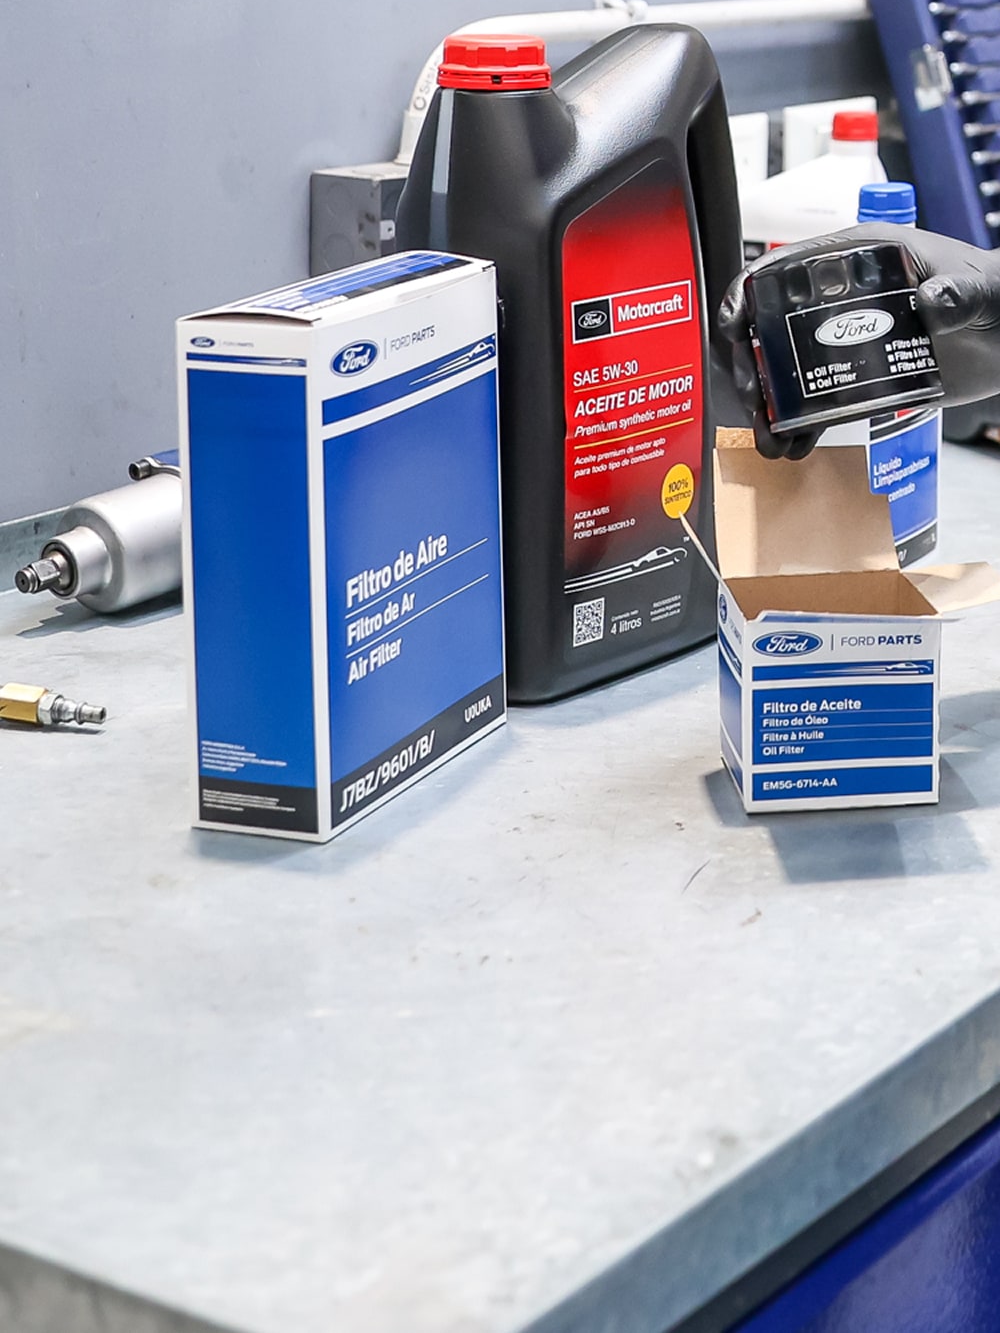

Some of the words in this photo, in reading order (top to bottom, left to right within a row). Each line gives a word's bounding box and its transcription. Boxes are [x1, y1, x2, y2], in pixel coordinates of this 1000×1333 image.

[617, 294, 684, 322] Motorcraft
[583, 312, 602, 327] Ford
[833, 315, 878, 340] Ford
[339, 346, 373, 372] Ford
[390, 335, 410, 351] FORD
[410, 325, 436, 344] PARTS
[573, 368, 600, 387] SAE
[602, 359, 638, 381] 5W-30
[814, 366, 828, 377] Oil
[828, 361, 852, 374] Filter
[833, 371, 857, 386] Filter
[574, 391, 626, 418] ACEITE
[628, 387, 646, 409] DE
[648, 375, 693, 401] MOTOR
[574, 420, 618, 437] Premium
[619, 409, 656, 431] synthetic
[656, 404, 681, 418] motor
[681, 399, 692, 412] oil
[346, 565, 392, 608] Filtro
[394, 550, 414, 582] de
[416, 534, 448, 570] Aire
[346, 613, 382, 646] Filtro
[383, 601, 400, 626] de
[400, 592, 416, 616] Ar
[610, 623, 617, 635] 4
[619, 617, 642, 633] litros
[765, 635, 809, 653] Ford
[840, 635, 876, 647] FORD
[877, 634, 923, 645] PARTS
[347, 656, 369, 685] Air
[369, 638, 402, 672] Filter
[763, 702, 799, 714] Filtro
[800, 700, 818, 712] de
[819, 698, 862, 711] Aceite
[762, 718, 790, 727] Filtro
[790, 717, 803, 726] de
[804, 714, 829, 725] Óleo
[762, 732, 789, 742] Filtre
[798, 730, 824, 740] Huile
[762, 746, 777, 756] Oil
[778, 745, 805, 755] Filter
[339, 729, 436, 813] J7BZ/9601/B/
[762, 777, 838, 791] EM5G-6714-AA
